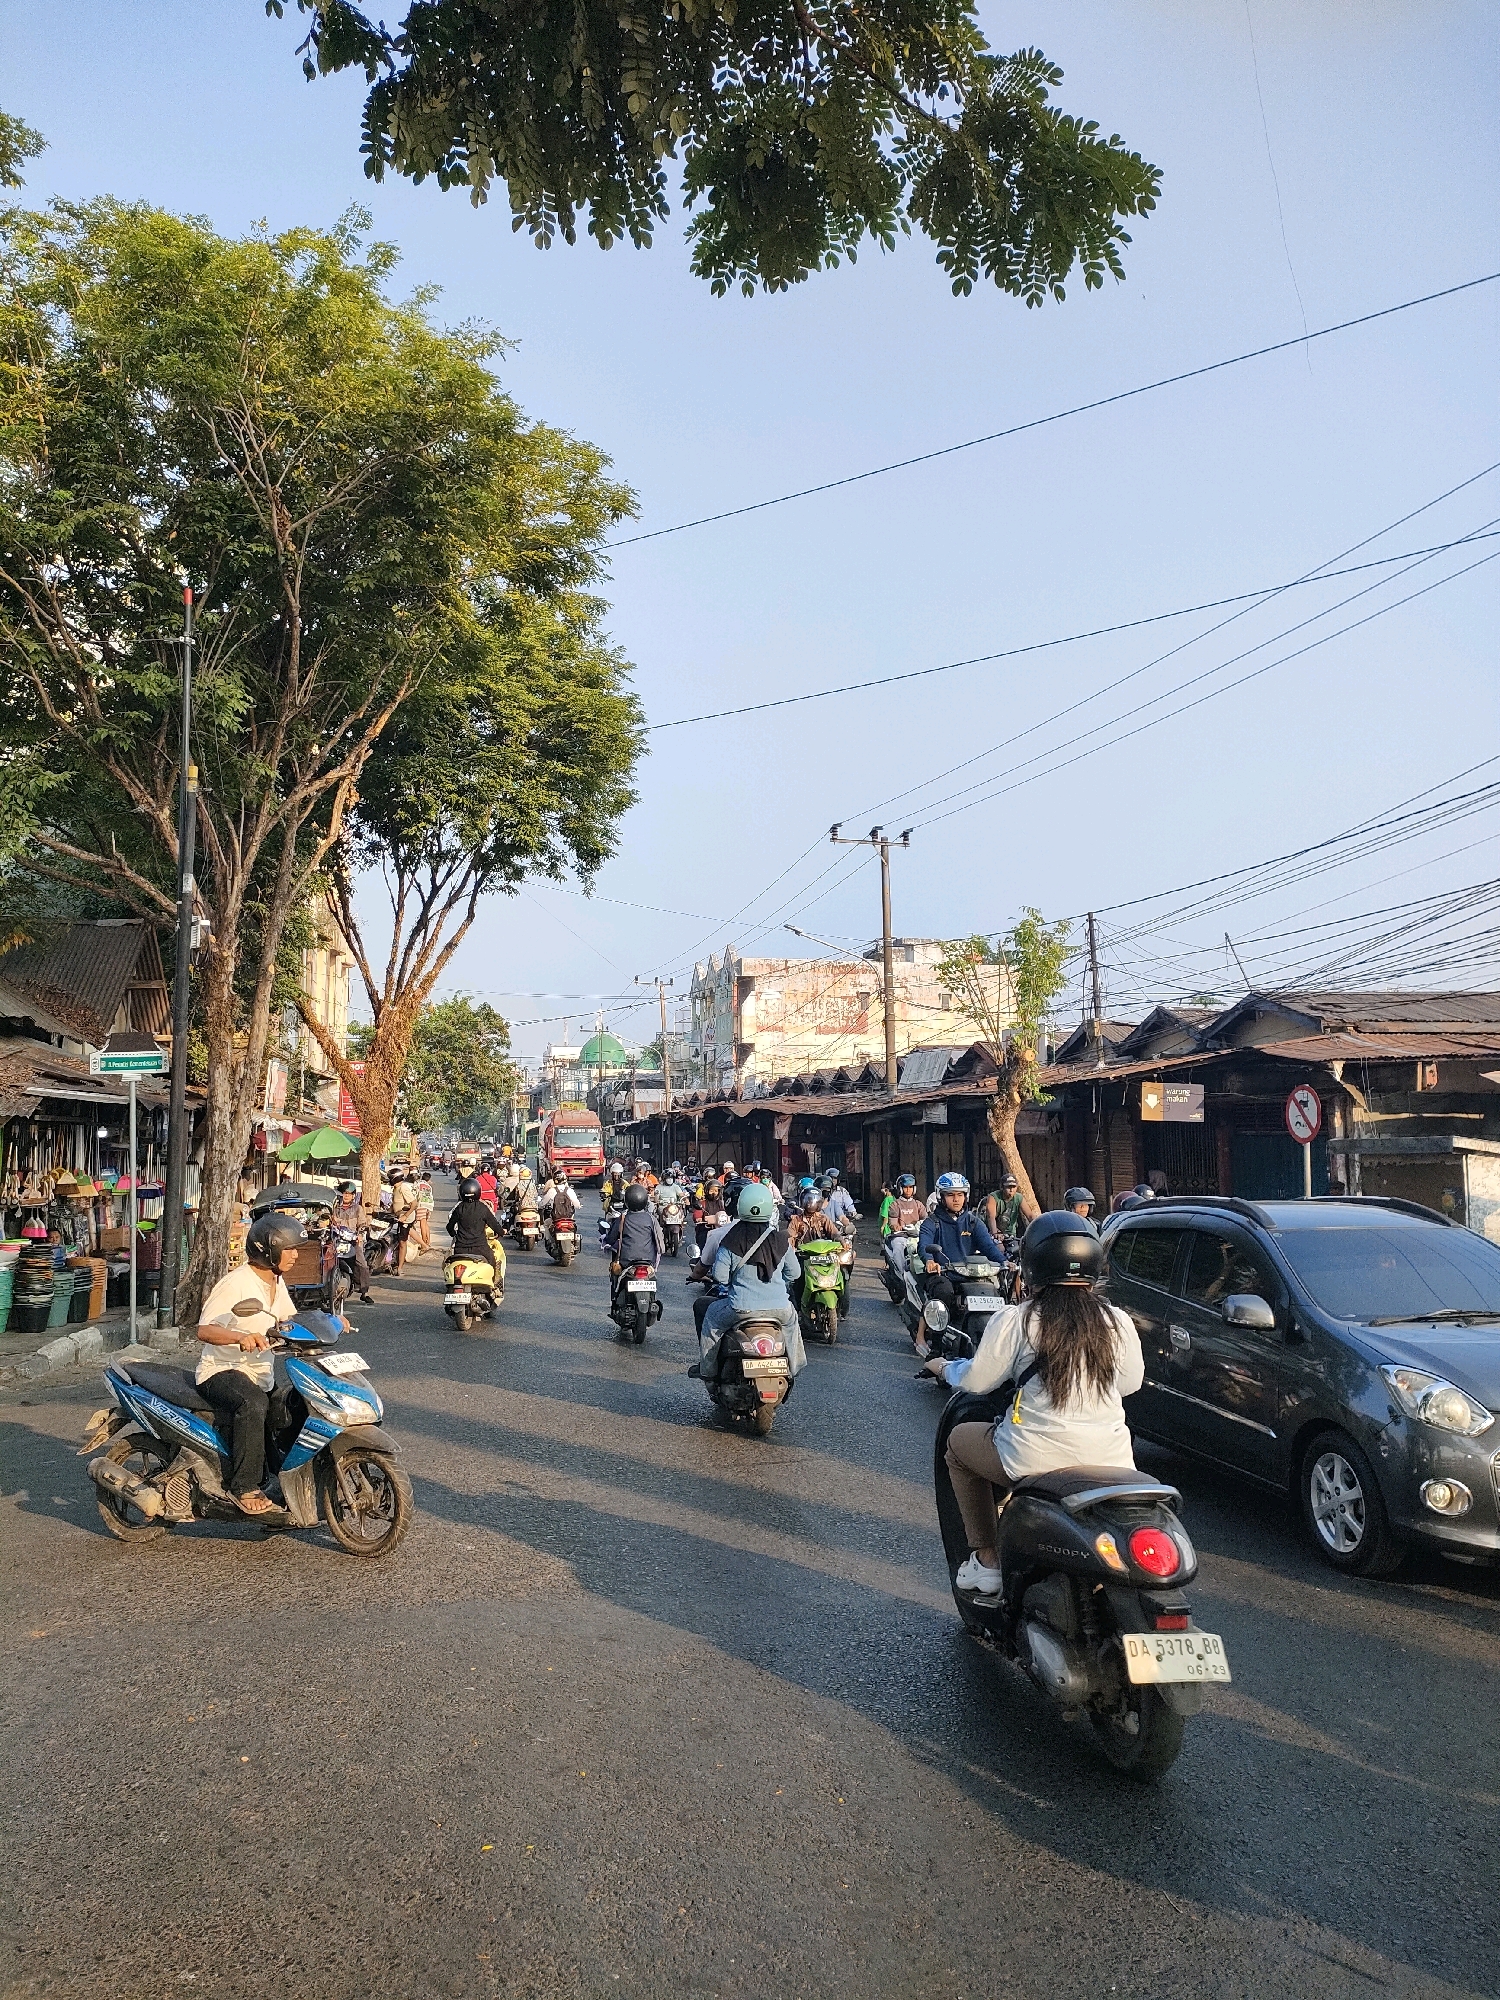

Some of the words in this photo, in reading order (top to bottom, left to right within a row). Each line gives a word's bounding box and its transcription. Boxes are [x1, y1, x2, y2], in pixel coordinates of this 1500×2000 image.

[1166, 1089, 1191, 1097] warung
[1166, 1095, 1188, 1103] makan
[151, 1396, 191, 1429] VARIO
[1038, 1543, 1090, 1559] SCOOPY
[1128, 1639, 1151, 1658] DA
[1156, 1638, 1195, 1656] 5378
